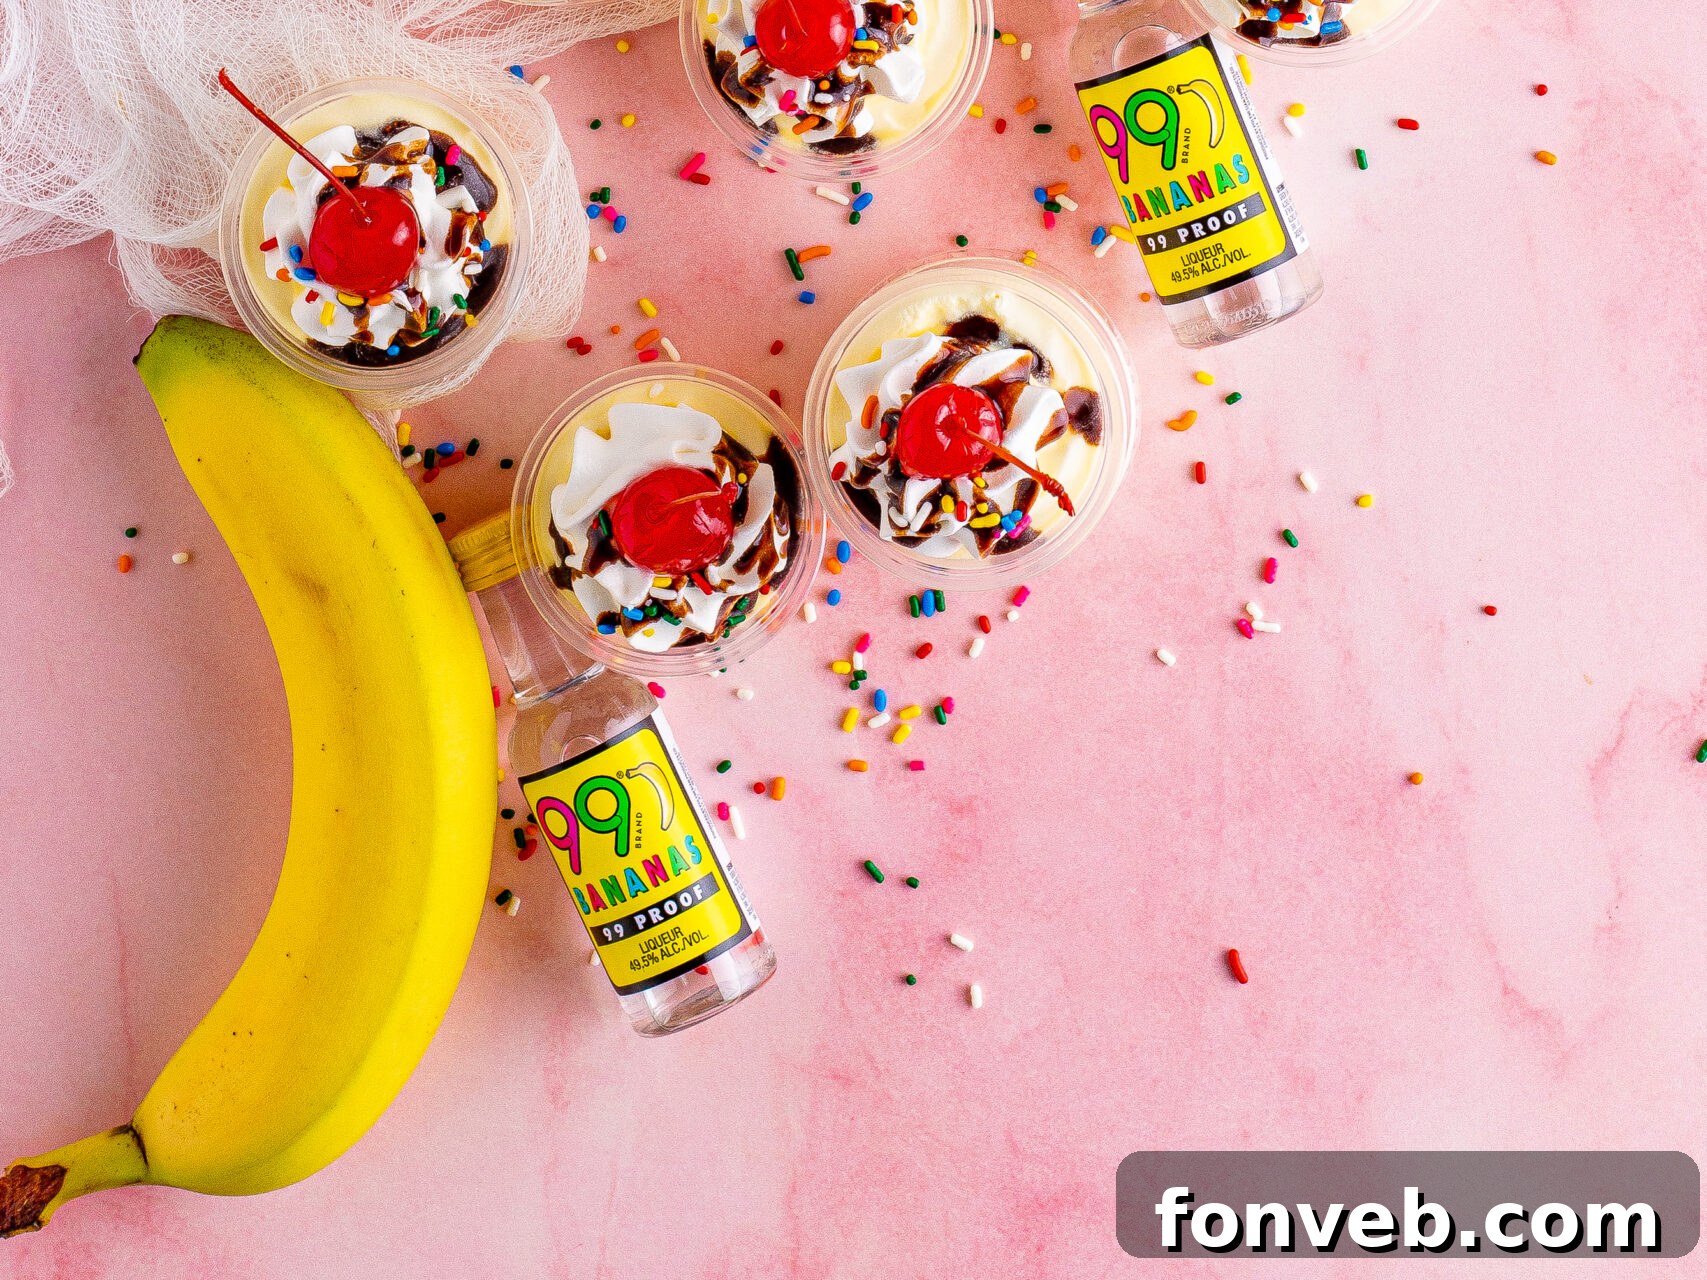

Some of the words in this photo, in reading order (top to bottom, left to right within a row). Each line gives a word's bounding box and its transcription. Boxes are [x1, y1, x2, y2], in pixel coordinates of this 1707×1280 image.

[1090, 88, 1180, 184] 99
[1181, 127, 1191, 164] BRAND
[1121, 153, 1249, 223] BANANAS
[1147, 234, 1167, 252] 99
[1176, 202, 1248, 243] PROOF
[1171, 265, 1200, 283] 49.5%
[1180, 242, 1226, 267] LIQUEUR
[536, 775, 631, 876] 99
[635, 812, 643, 849] BRAND
[572, 835, 702, 915] BANANAS
[602, 923, 625, 941] 99
[633, 884, 703, 930] PROOF
[638, 926, 684, 954] LIQUEUR
